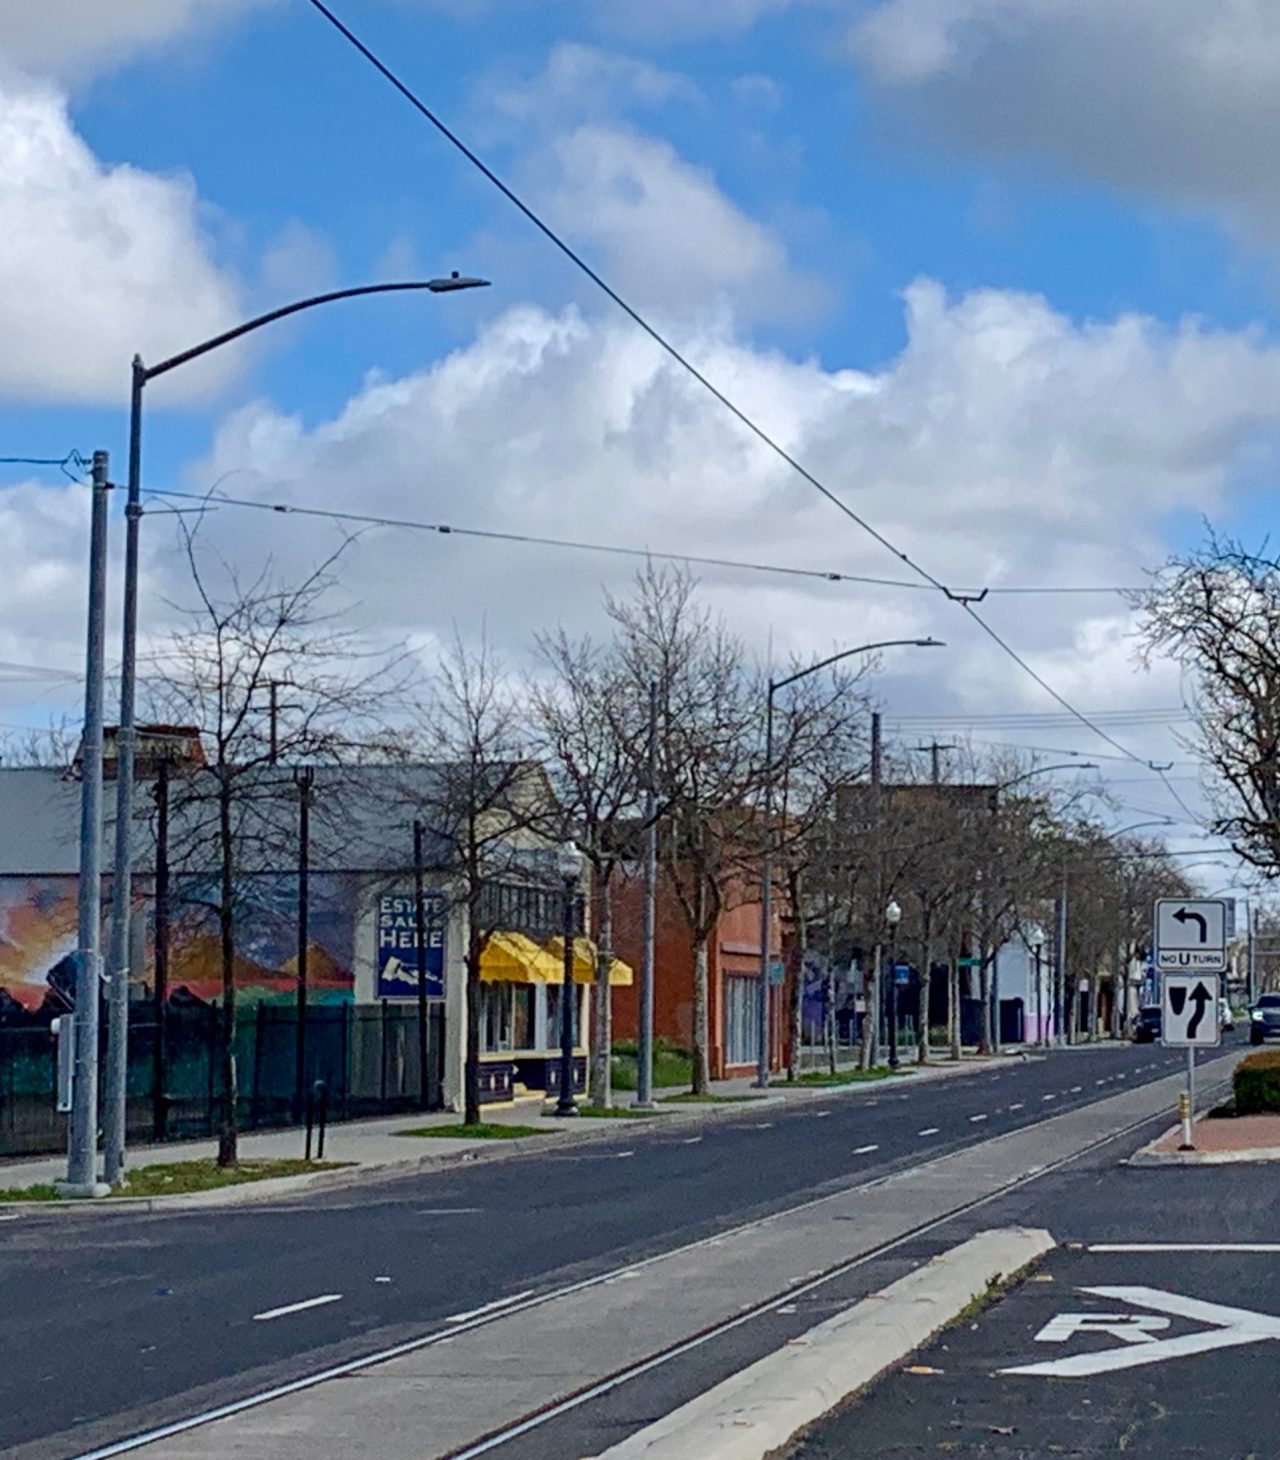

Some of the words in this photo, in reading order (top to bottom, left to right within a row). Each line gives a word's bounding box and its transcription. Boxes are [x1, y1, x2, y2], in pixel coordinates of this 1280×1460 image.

[380, 929, 442, 948] HERE
[1161, 954, 1177, 963] NO
[1179, 952, 1190, 965] U
[1193, 954, 1221, 964] TURN
